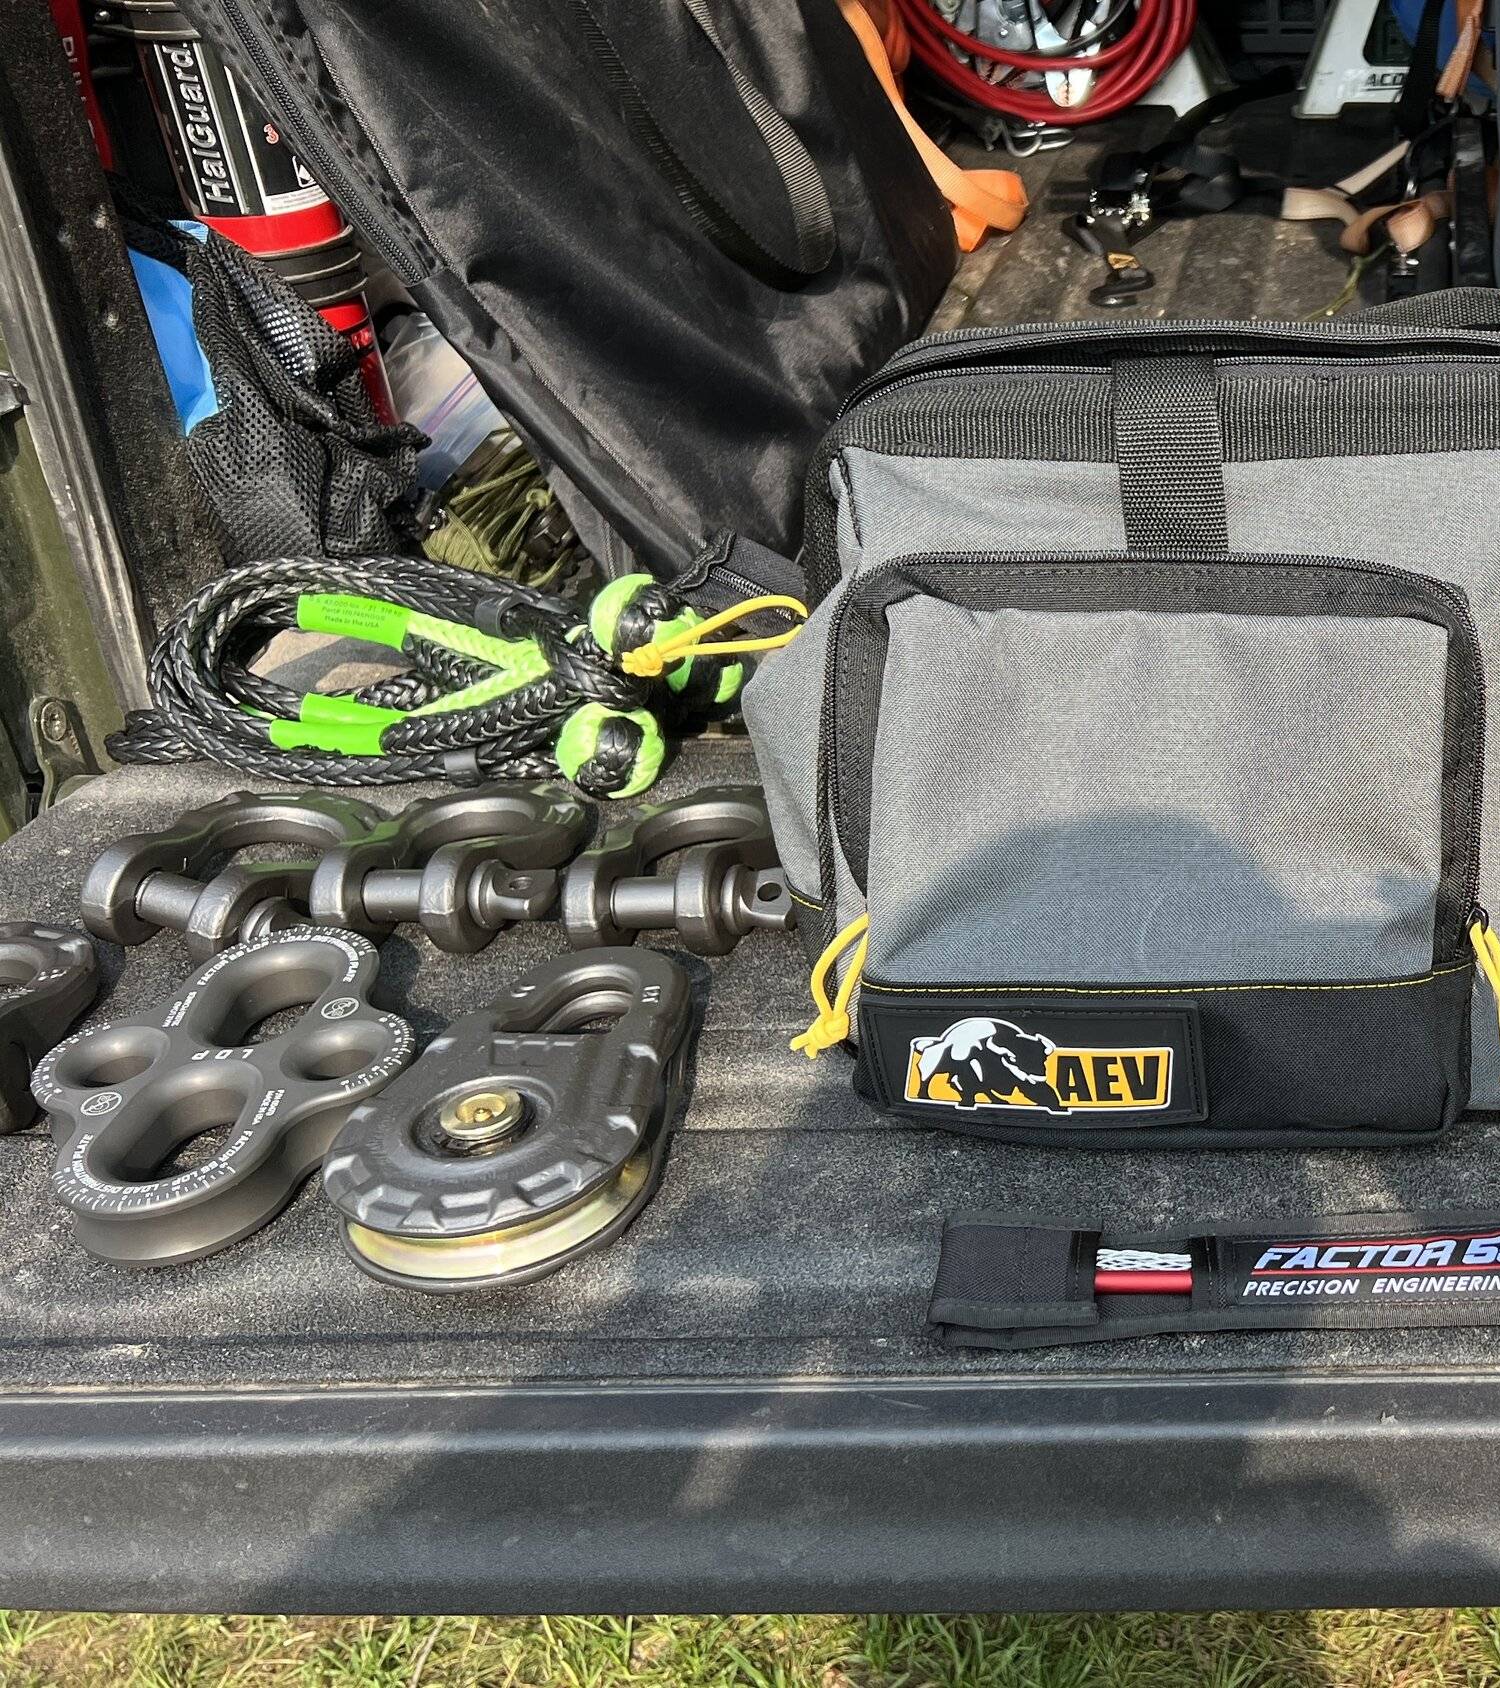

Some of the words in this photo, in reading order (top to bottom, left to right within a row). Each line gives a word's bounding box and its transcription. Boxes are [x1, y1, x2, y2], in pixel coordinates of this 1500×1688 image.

[1056, 1055, 1160, 1102] AEV
[72, 1133, 94, 1160] PLATE
[218, 1130, 254, 1162] FACTOR
[122, 1183, 160, 1195] LOAD
[1253, 1238, 1458, 1270] FACTOR
[1242, 1277, 1361, 1297] PRECISION
